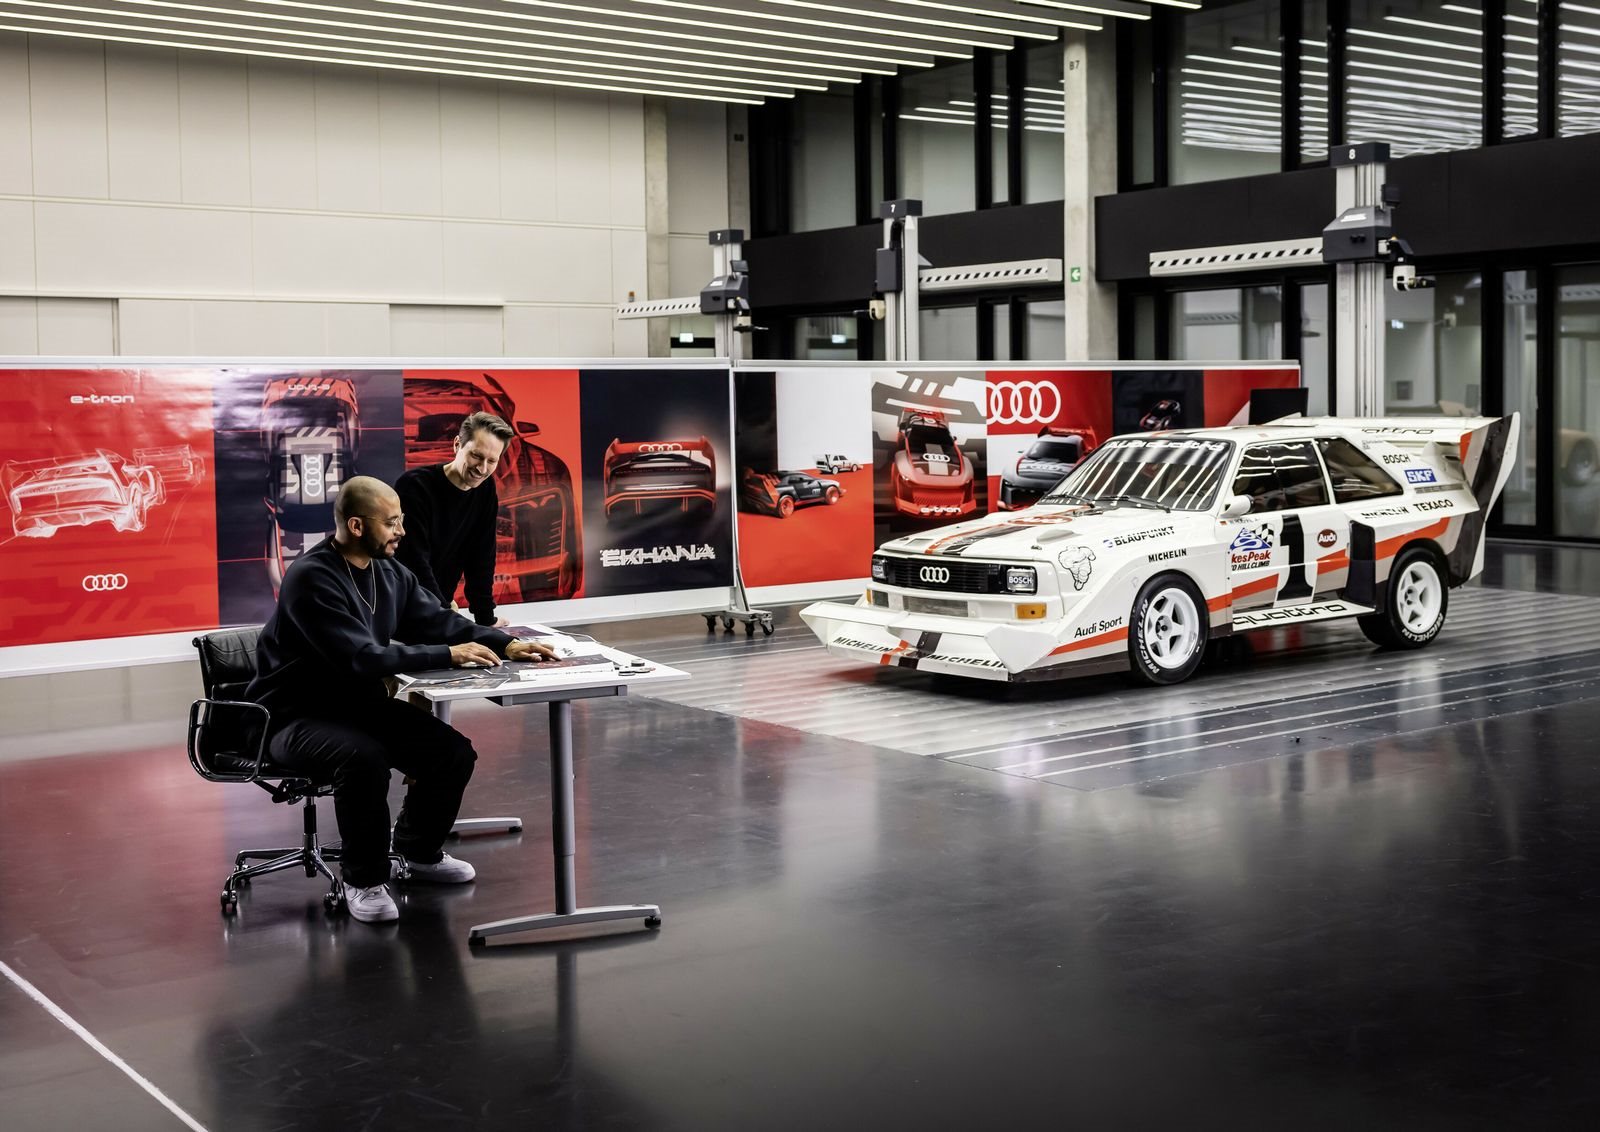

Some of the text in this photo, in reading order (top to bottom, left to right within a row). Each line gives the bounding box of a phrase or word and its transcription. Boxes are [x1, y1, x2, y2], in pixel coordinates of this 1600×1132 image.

[1348, 148, 1356, 160] 8
[70, 393, 135, 404] e-tron
[1361, 427, 1434, 435] attro
[1382, 454, 1411, 465] BOSCH
[1406, 469, 1434, 483] SKF
[1413, 499, 1454, 512] TEXACO
[1114, 526, 1175, 546] BLAUPUNKT
[1318, 532, 1337, 543] Audi
[1148, 548, 1187, 563] MICHELIN
[1247, 550, 1271, 562] Peak
[1276, 514, 1314, 601] 1
[1008, 576, 1033, 585] BOSCH
[1233, 604, 1348, 625] quattro
[1074, 616, 1123, 638] Audi Sport
[1401, 612, 1444, 642] MICHELIN
[1137, 599, 1160, 674] MICHELIN
